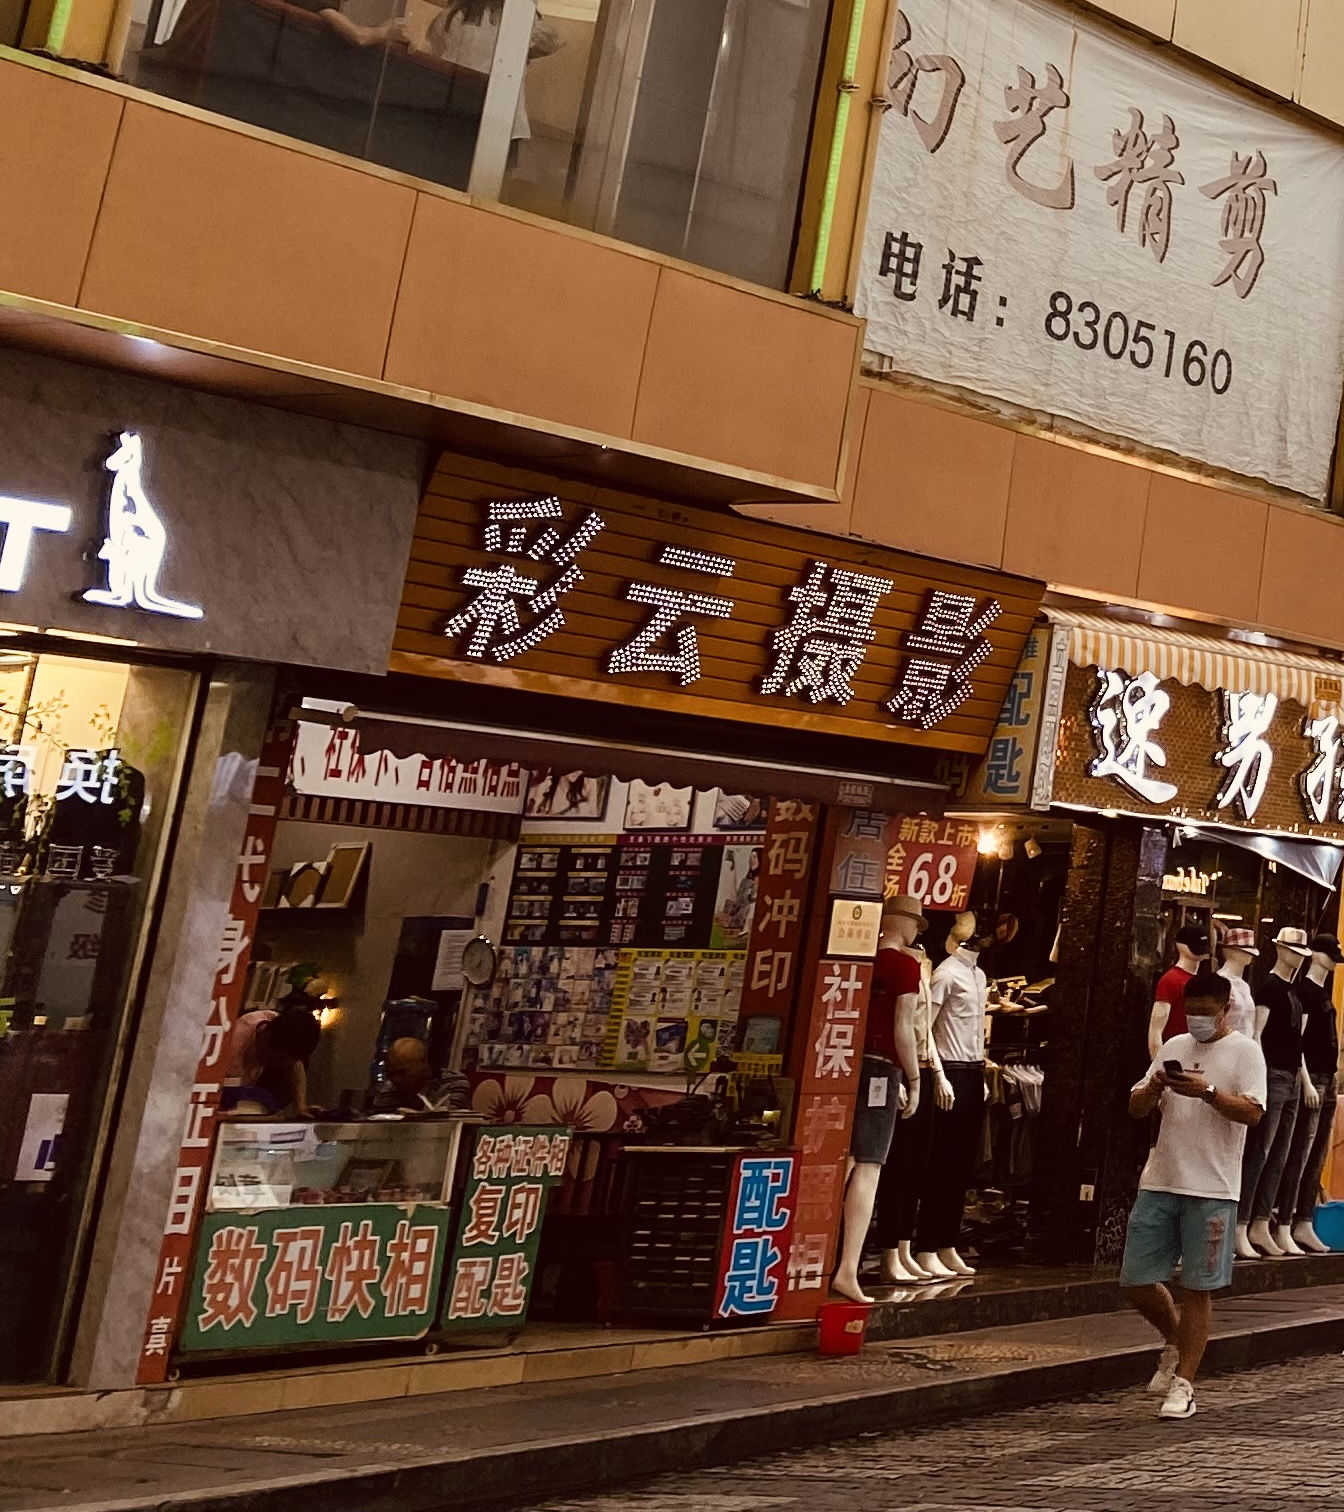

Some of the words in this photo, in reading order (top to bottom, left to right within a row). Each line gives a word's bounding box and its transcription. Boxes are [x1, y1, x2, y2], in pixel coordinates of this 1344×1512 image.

[878, 230, 1009, 328] 电话：
[1044, 290, 1233, 396] 8305160
[444, 494, 1003, 731] 彩云摄影
[897, 816, 975, 849] 新款上市
[907, 851, 958, 906] 6.8
[950, 883, 968, 909] 折
[473, 1134, 570, 1180] 各种证件相
[462, 1182, 544, 1246] 复印
[719, 1157, 796, 1319] 配匙
[199, 1219, 441, 1332] 数码快相
[447, 1254, 531, 1320] 配匙
